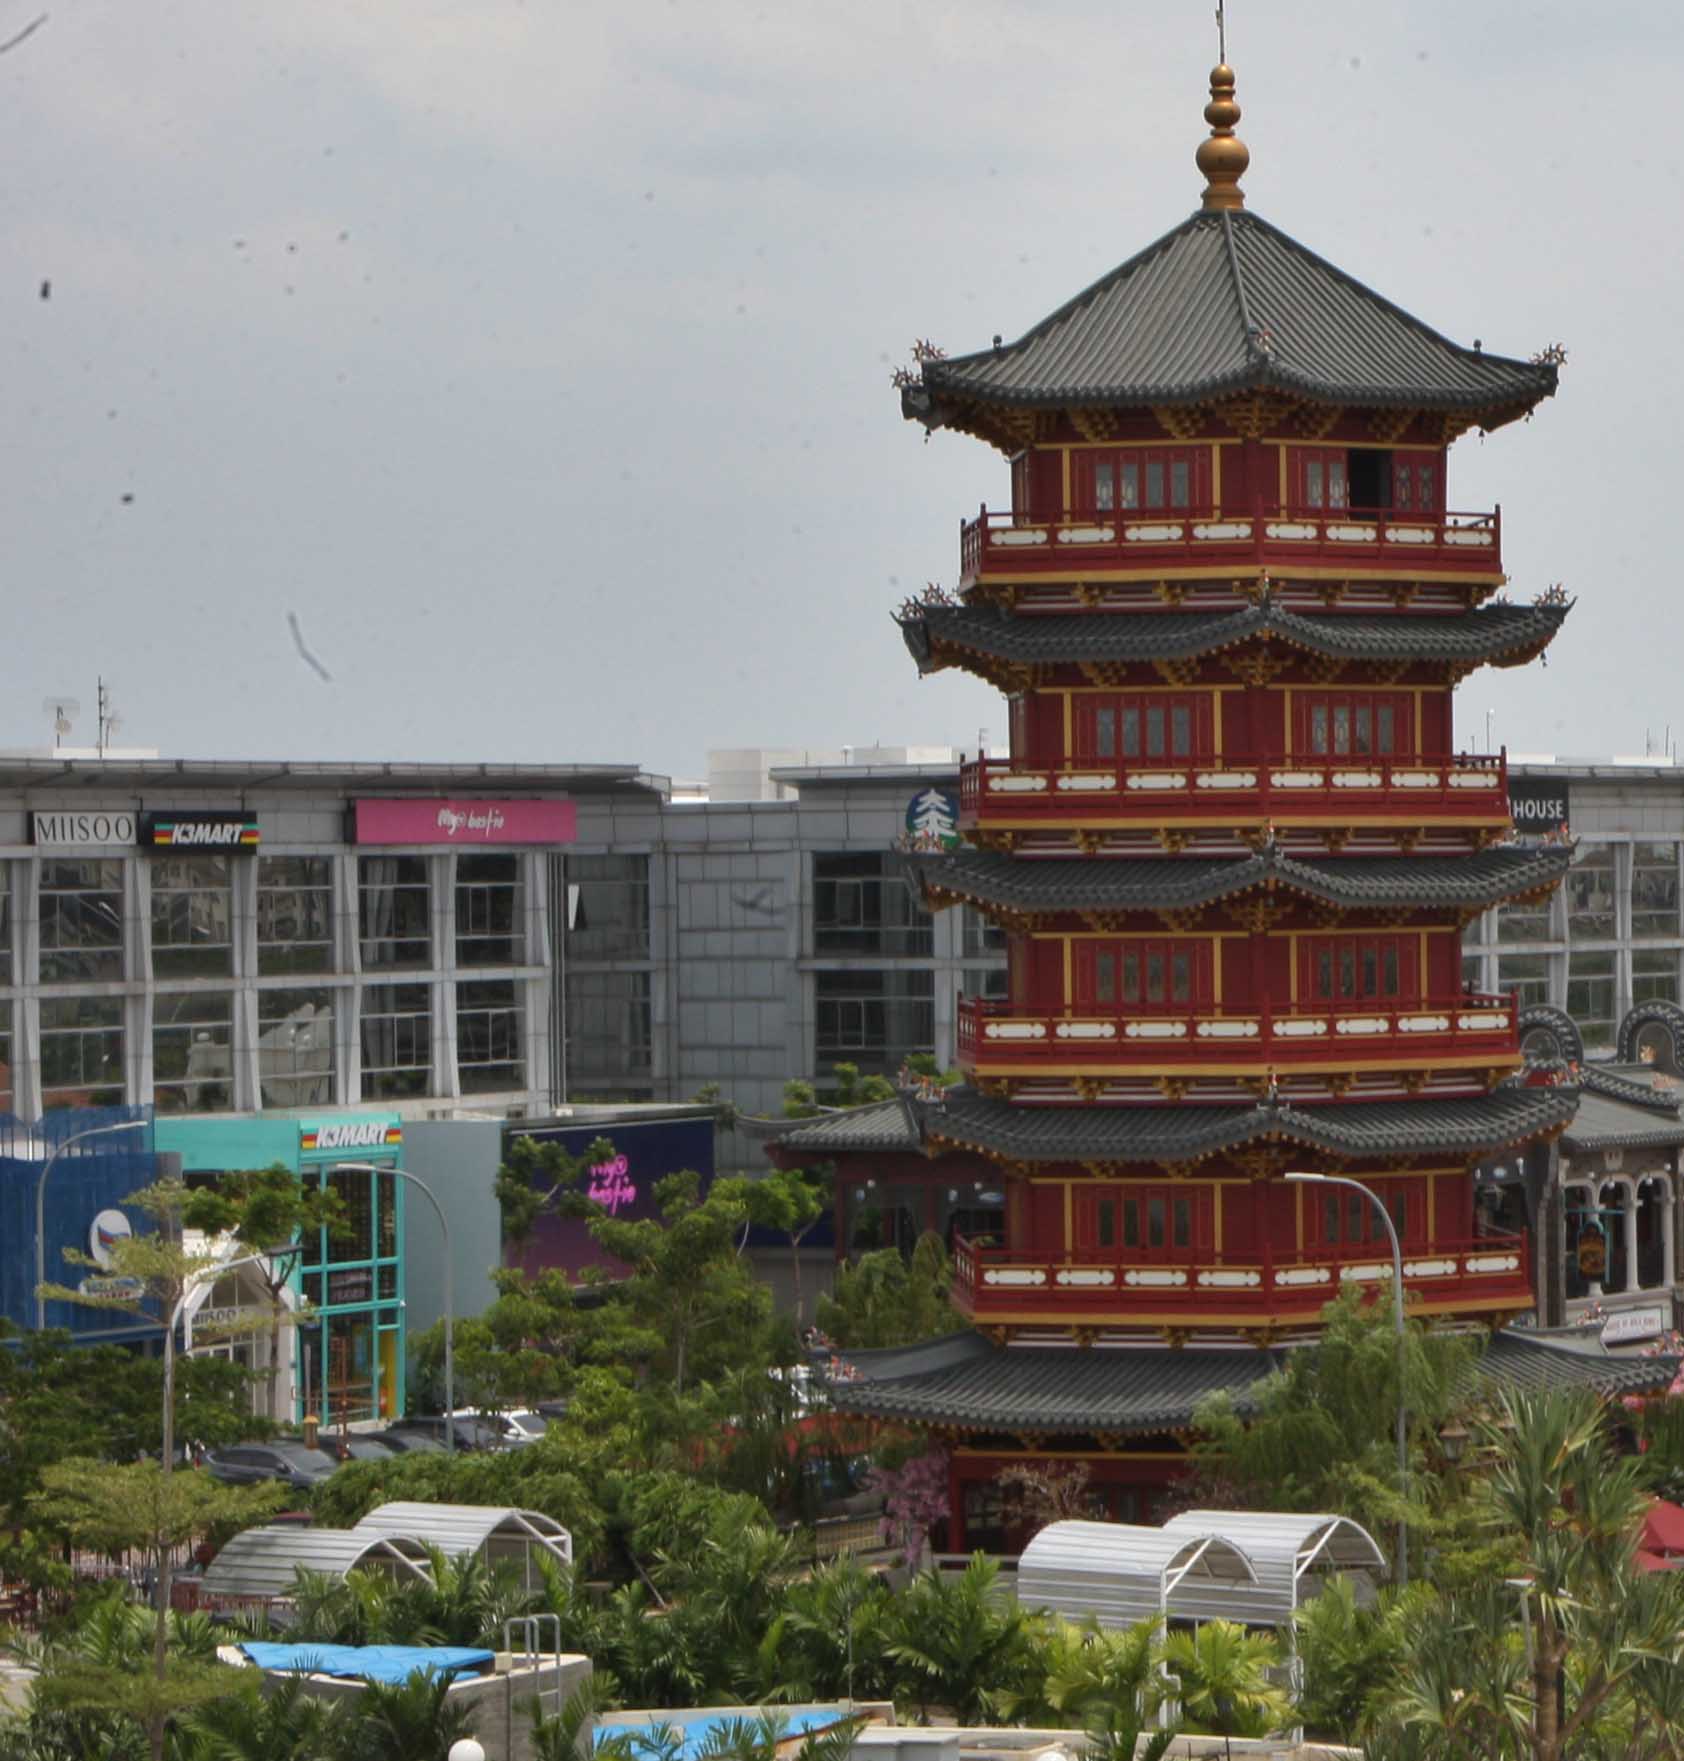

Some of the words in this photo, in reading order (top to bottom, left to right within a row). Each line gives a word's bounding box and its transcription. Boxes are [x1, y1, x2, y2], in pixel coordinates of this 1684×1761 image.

[36, 815, 133, 843] MIISOO
[171, 823, 244, 845] K3MART
[315, 1123, 389, 1148] K3MART
